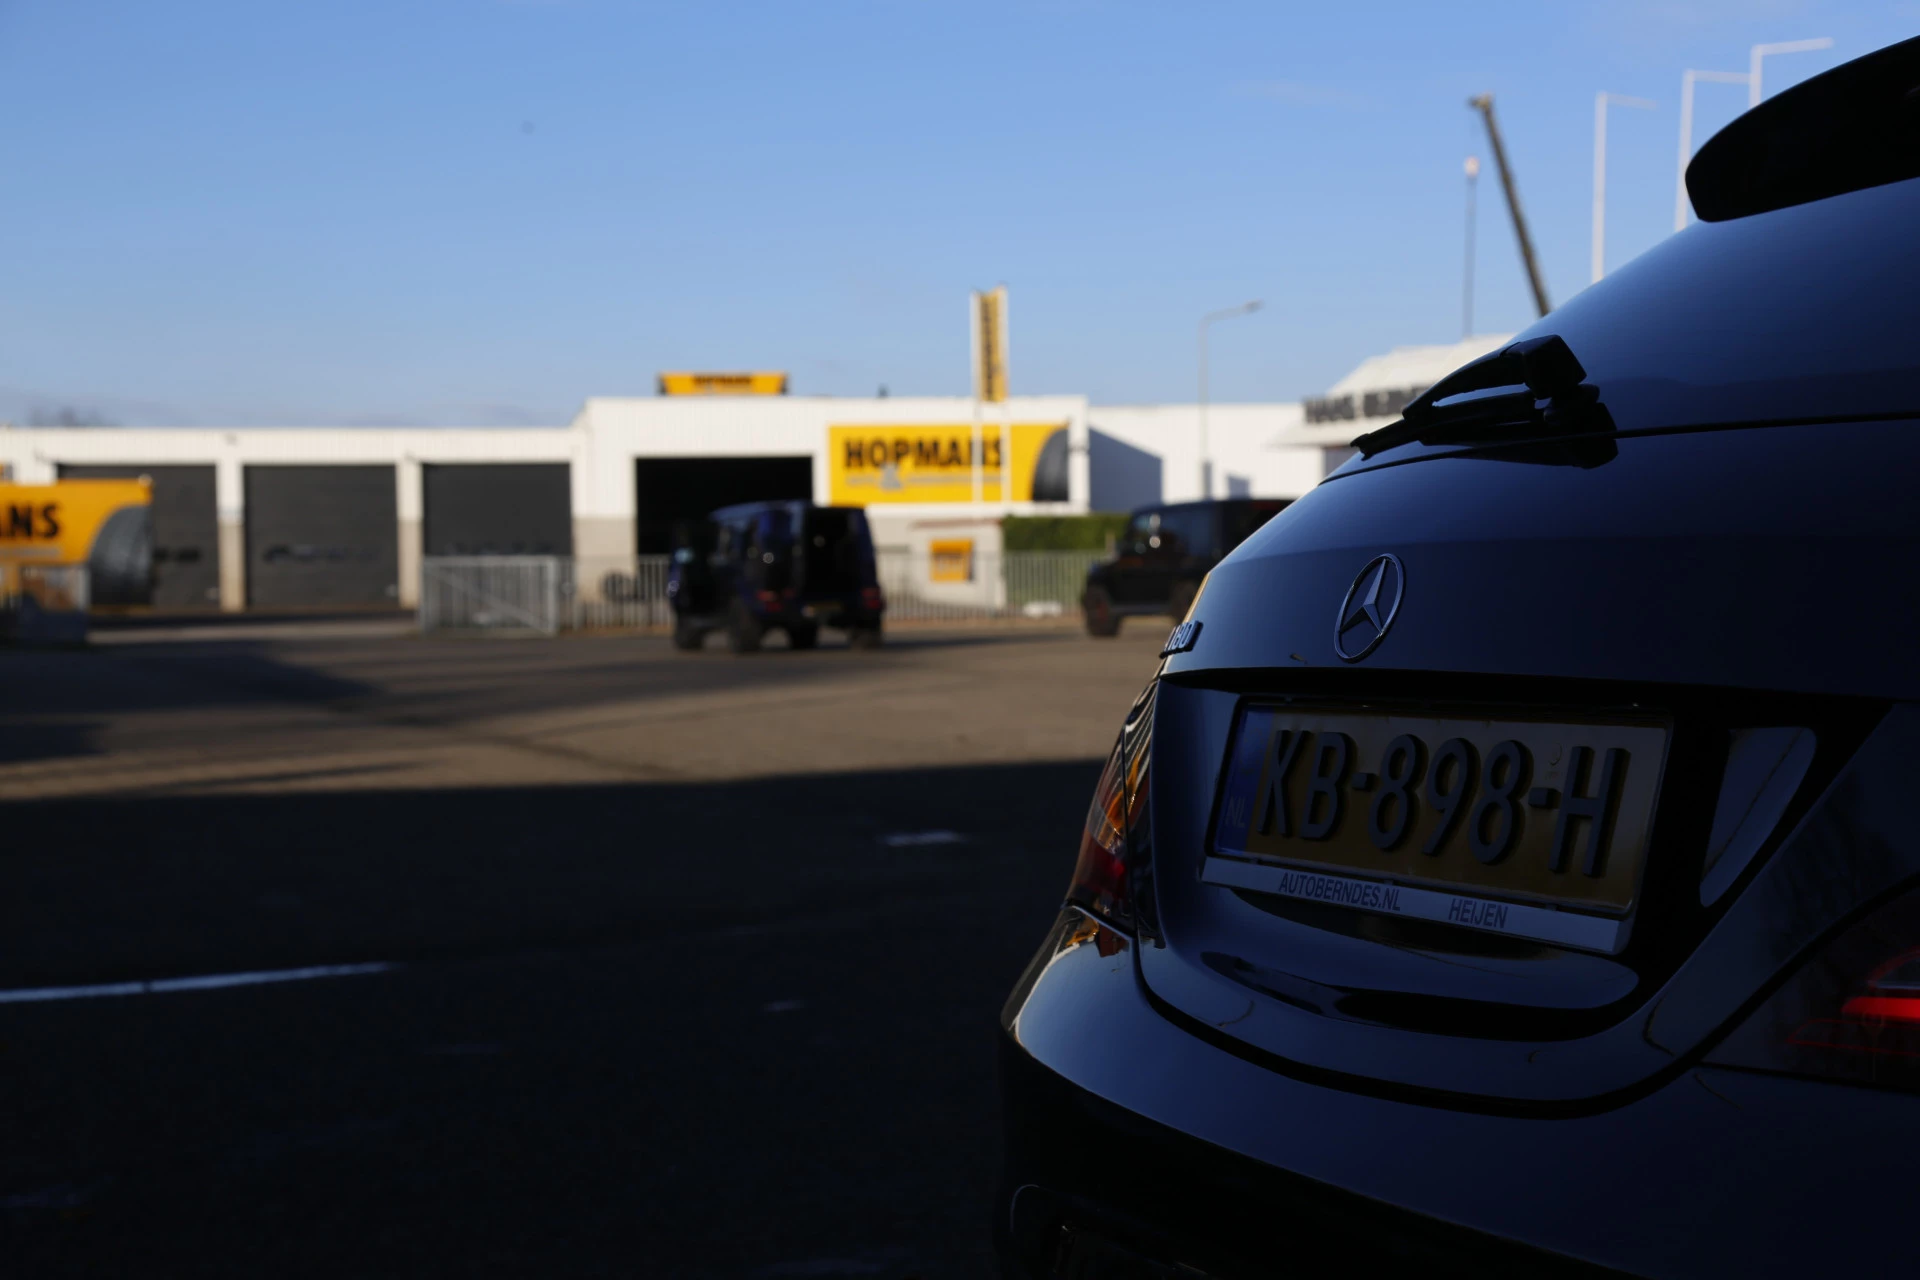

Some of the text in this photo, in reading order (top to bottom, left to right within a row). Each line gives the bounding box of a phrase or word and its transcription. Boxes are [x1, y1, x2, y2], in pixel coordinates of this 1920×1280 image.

[1224, 795, 1246, 829] NL
[1257, 729, 1631, 879] KB-898-H
[1278, 871, 1508, 929] AUTOBERNDES.NL HEIJEN
